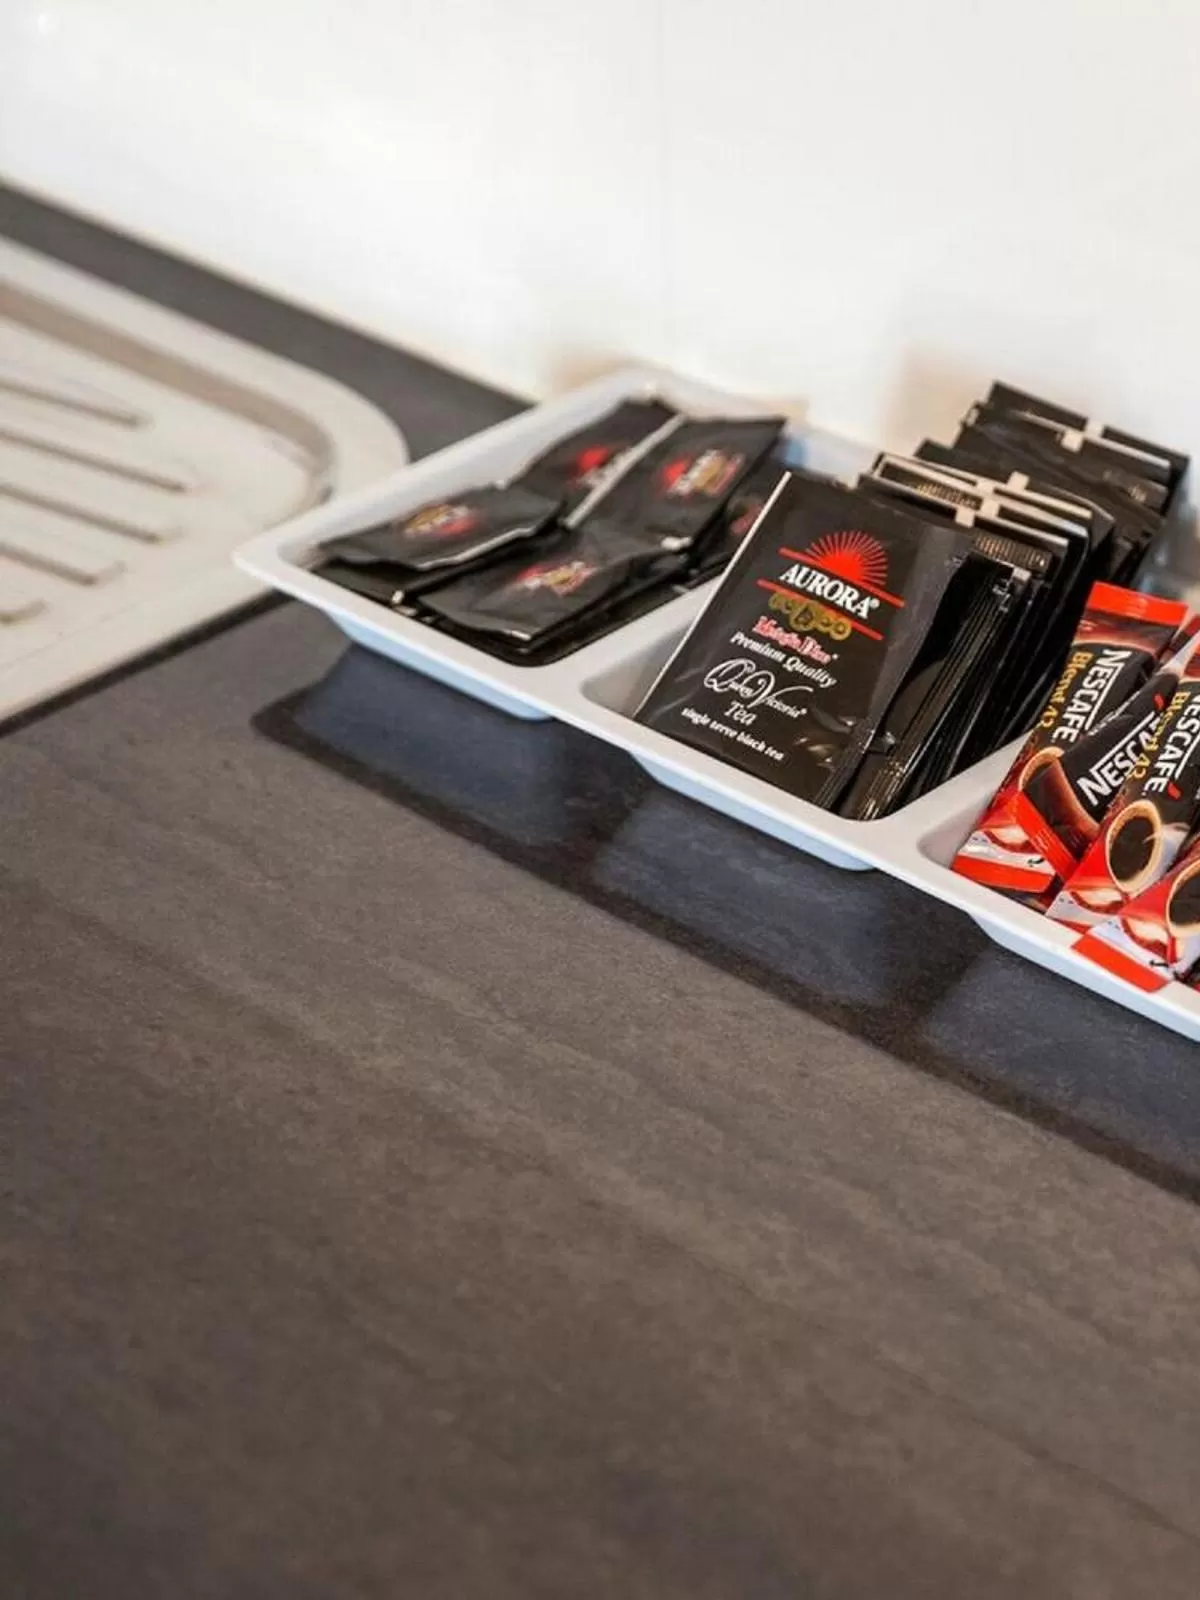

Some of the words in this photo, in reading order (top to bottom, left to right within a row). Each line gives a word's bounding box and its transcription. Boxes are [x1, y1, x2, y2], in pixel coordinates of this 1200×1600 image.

[730, 632, 787, 662] Premium
[783, 656, 837, 688] Quality
[1053, 651, 1094, 703] Blend
[724, 701, 757, 726] Tea
